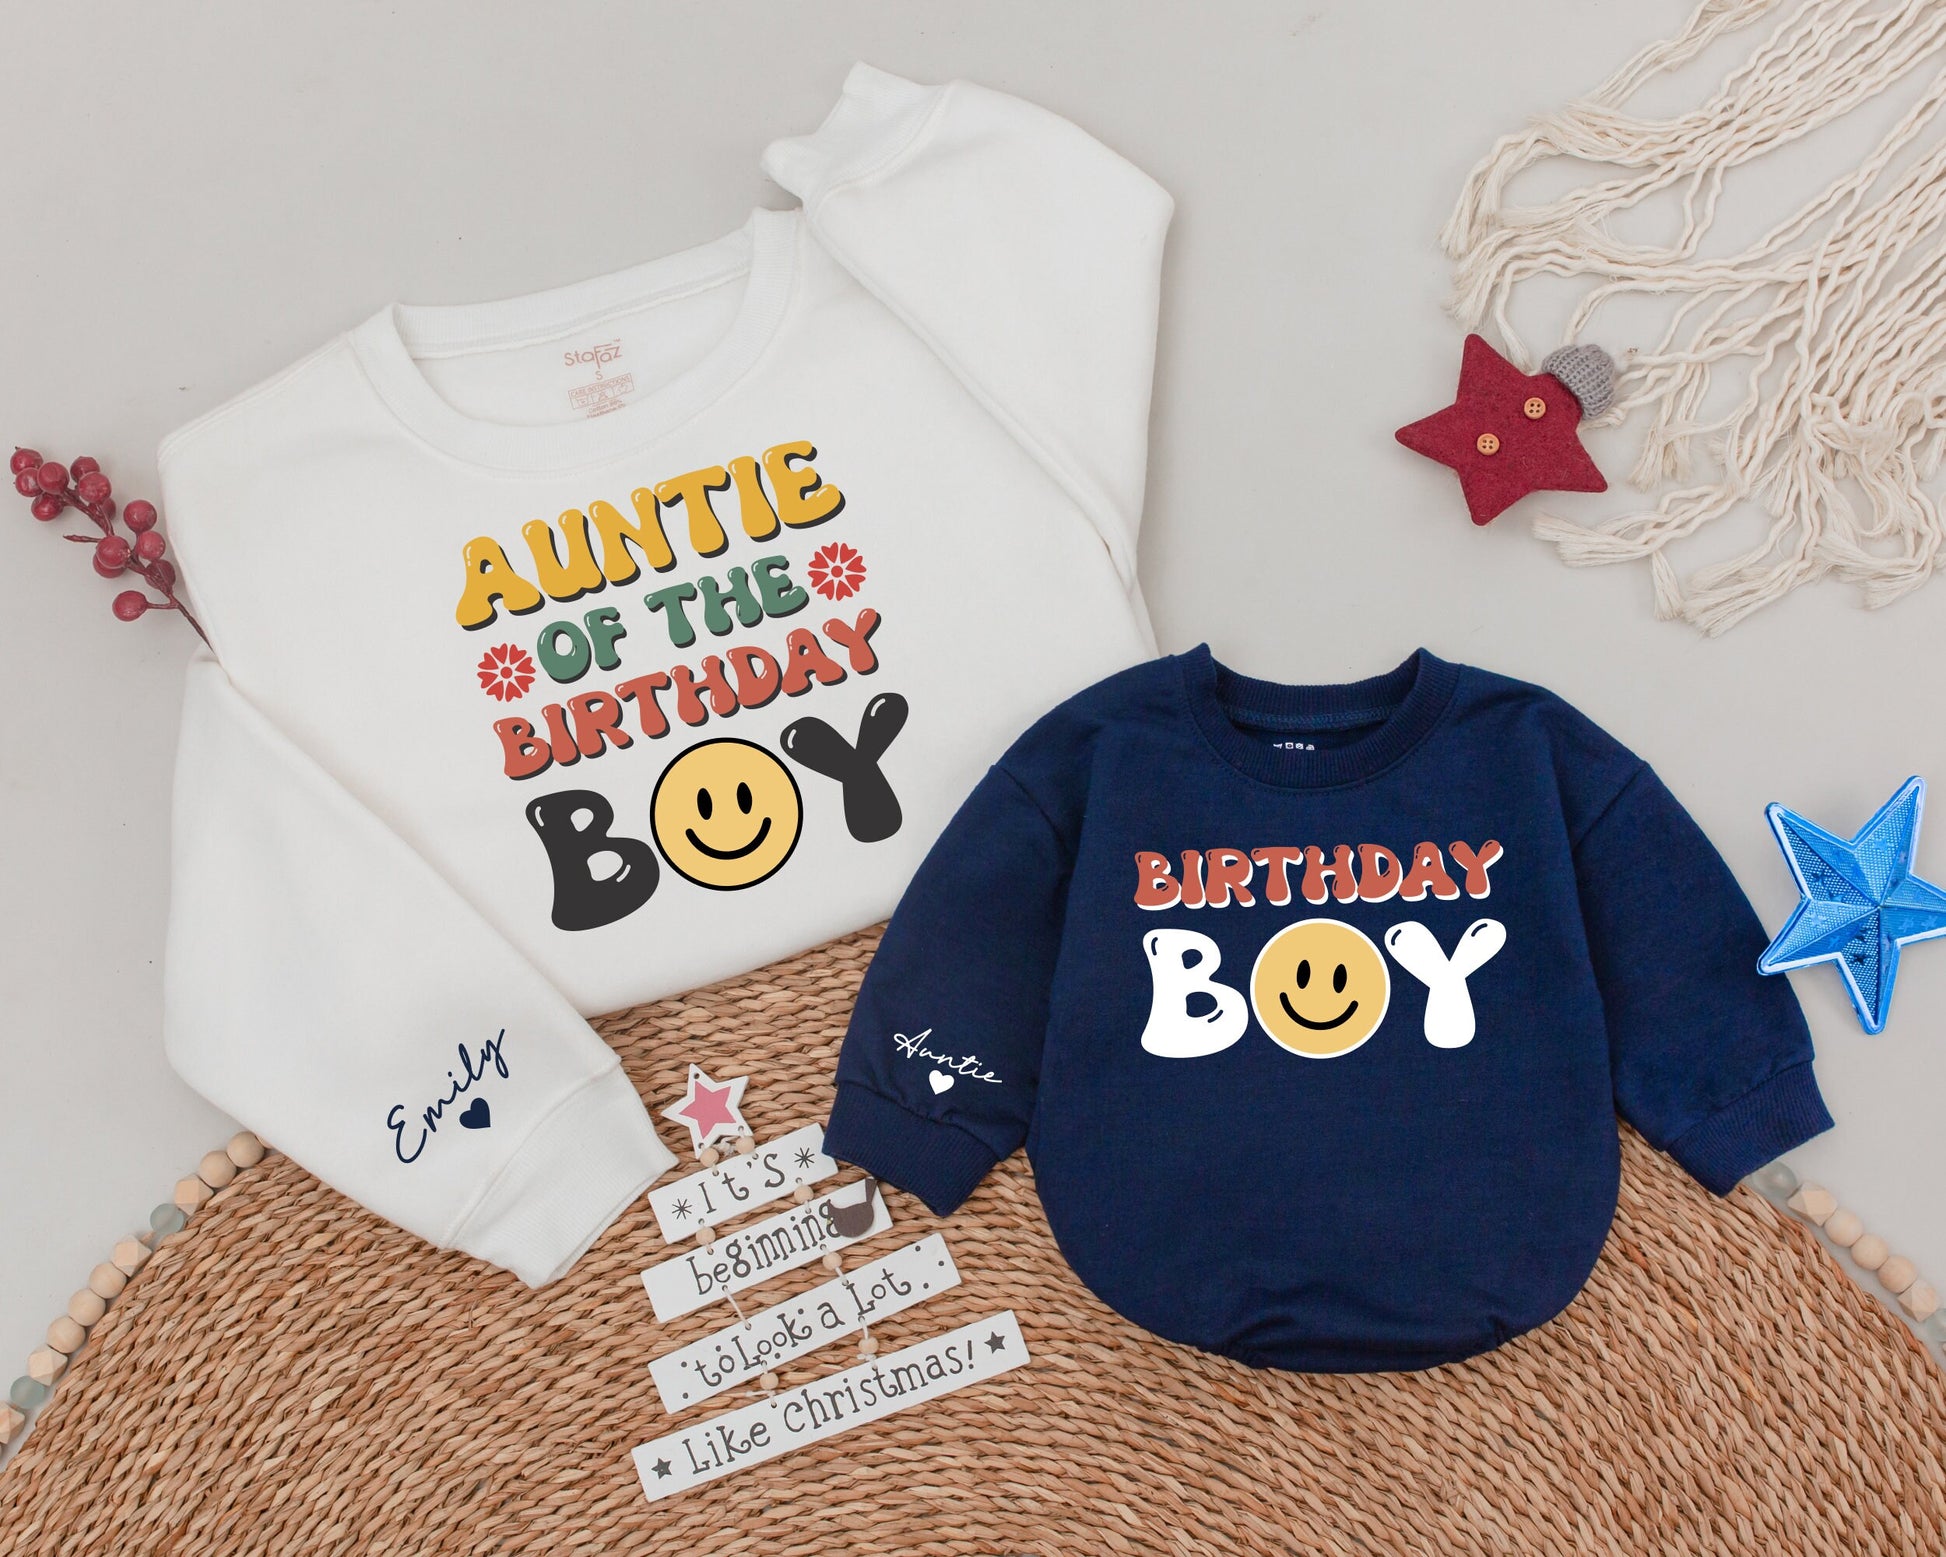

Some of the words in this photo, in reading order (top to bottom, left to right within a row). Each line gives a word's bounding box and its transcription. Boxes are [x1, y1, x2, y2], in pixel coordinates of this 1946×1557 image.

[455, 440, 846, 631] AUNTIE
[537, 606, 627, 684] OF
[643, 554, 810, 649] THE
[493, 608, 882, 781] BIRTHDAY
[1133, 839, 1504, 911] BIRTHDAY
[387, 1028, 509, 1163] Emily
[893, 1028, 1003, 1083] Auntie
[694, 1353, 735, 1388] to
[817, 1301, 846, 1330] a
[682, 1421, 771, 1475] Like
